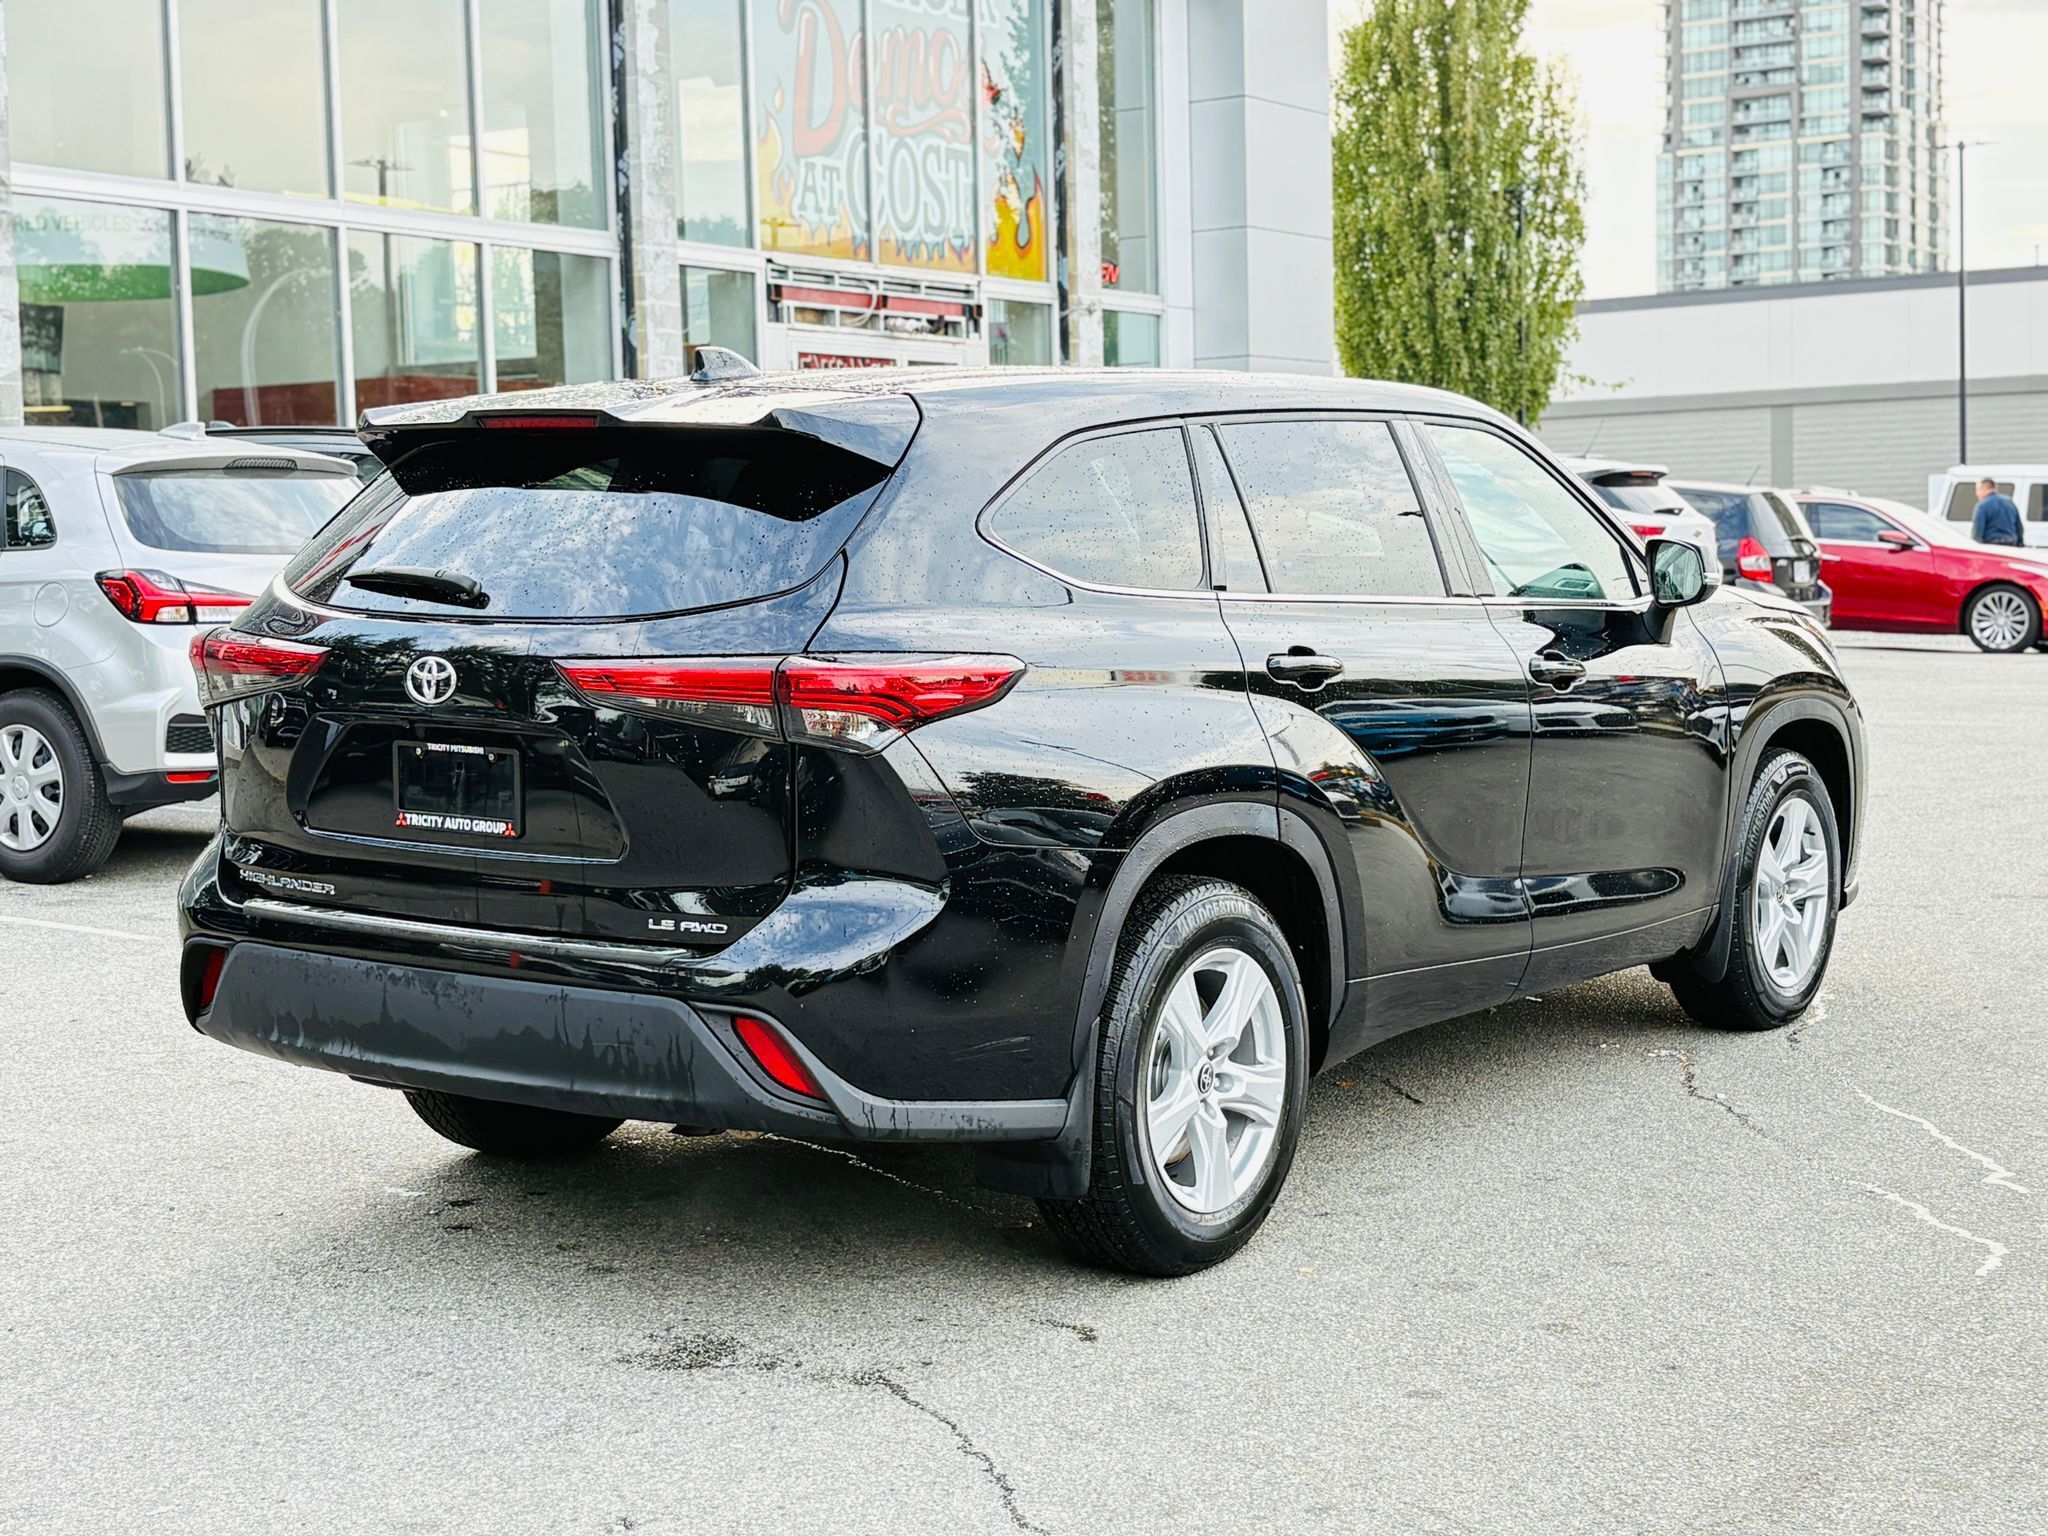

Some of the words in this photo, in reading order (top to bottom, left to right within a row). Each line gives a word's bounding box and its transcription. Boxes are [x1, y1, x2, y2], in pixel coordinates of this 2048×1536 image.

[798, 161, 841, 216] AT
[846, 131, 975, 237] COST
[52, 214, 130, 232] VEHICLES
[404, 813, 444, 828] TRICITY
[444, 817, 472, 831] AUTO
[472, 820, 507, 834] GROUP
[239, 869, 336, 895] HIGHLANDER
[648, 918, 676, 931] LE
[680, 921, 728, 934] AWD
